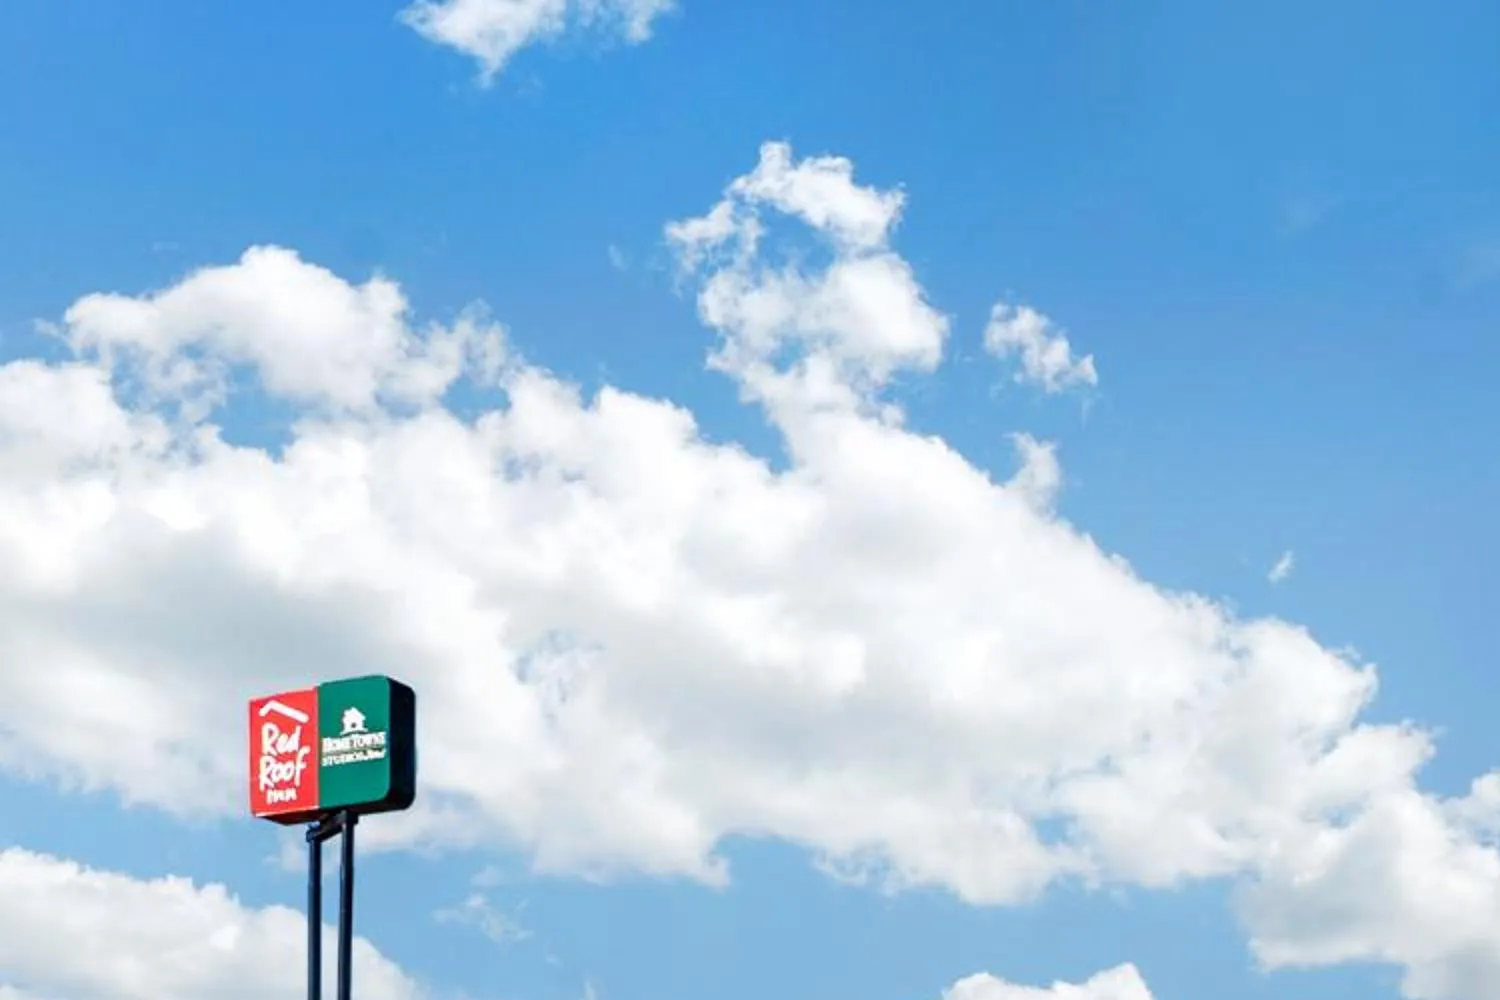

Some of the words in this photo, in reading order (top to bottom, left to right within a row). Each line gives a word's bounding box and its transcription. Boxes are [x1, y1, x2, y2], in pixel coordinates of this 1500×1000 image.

[261, 722, 302, 757] Red
[260, 746, 311, 792] Roof
[266, 787, 298, 805] INN
